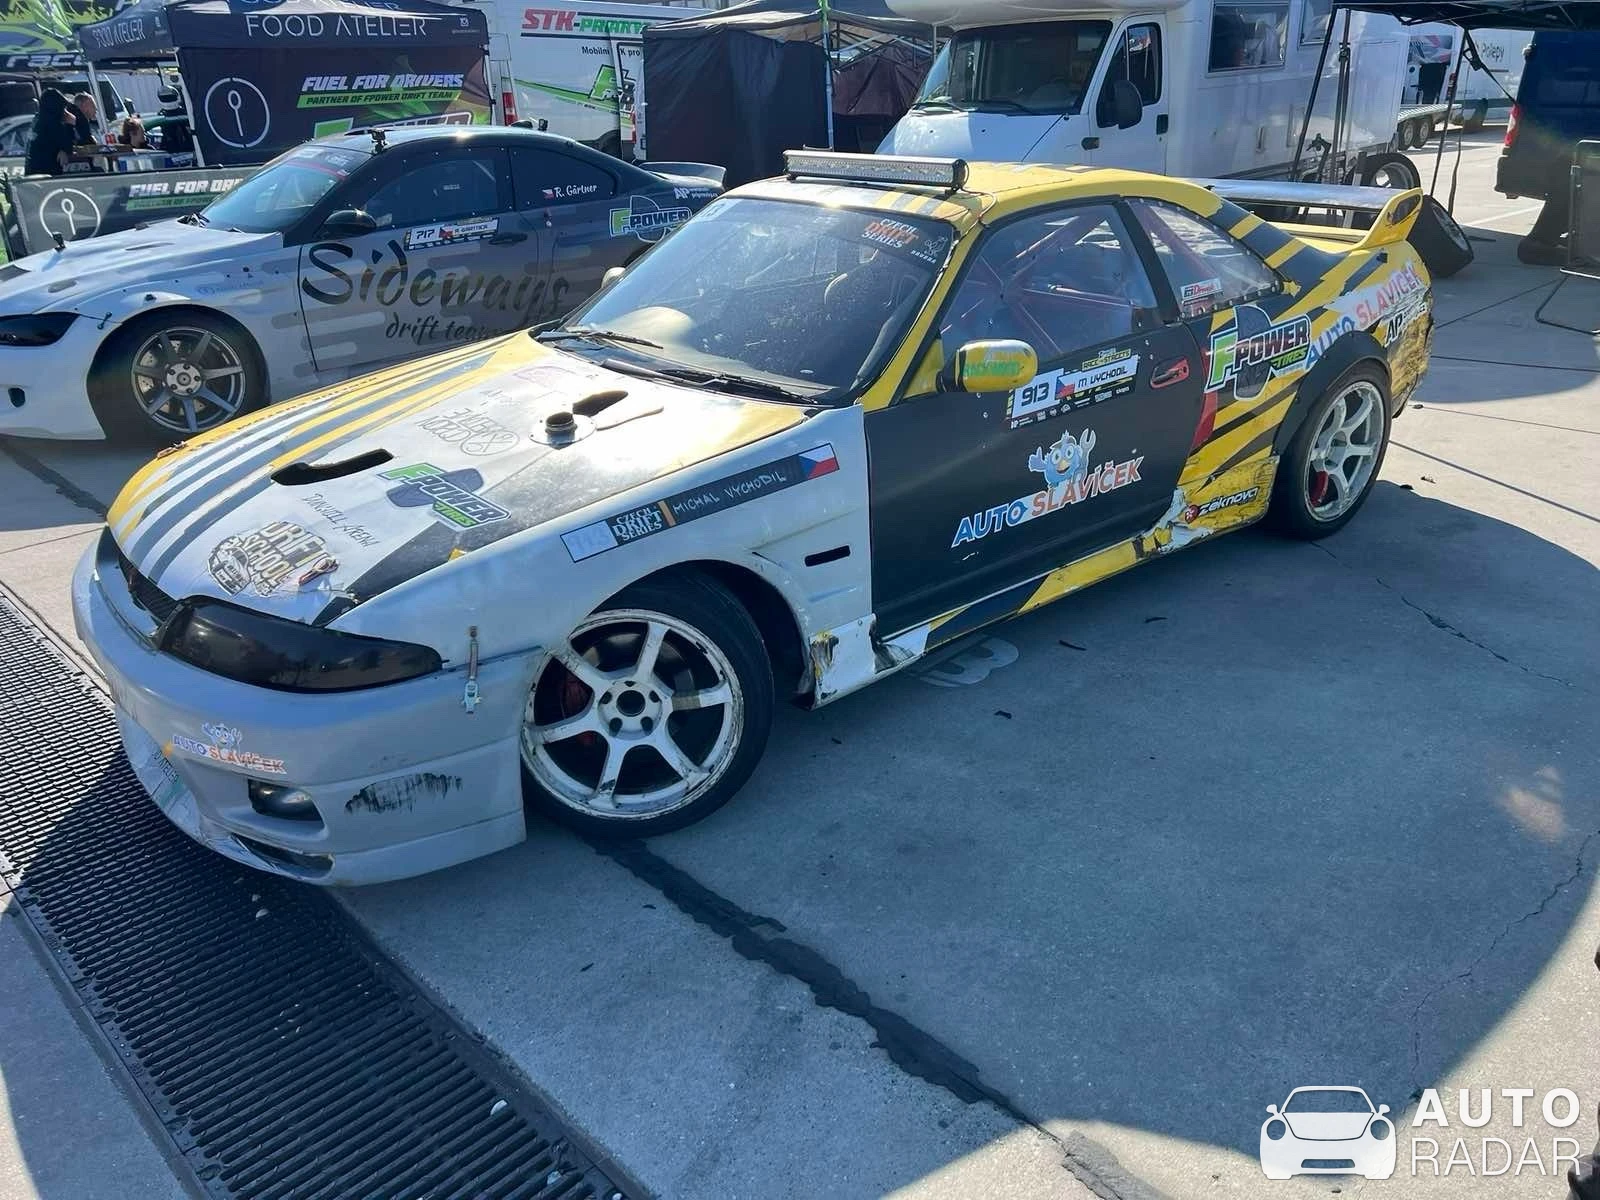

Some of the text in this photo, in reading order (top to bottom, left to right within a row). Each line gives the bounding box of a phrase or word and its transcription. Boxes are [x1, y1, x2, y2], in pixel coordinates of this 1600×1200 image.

[92, 18, 147, 48] FOOD ATELIER
[245, 15, 426, 37] FOOD ATELIER
[302, 73, 464, 92] FUEL FOR DRIVERS
[306, 91, 453, 105] PARTNER OF FPOWER DRIFT TEAM
[129, 183, 171, 197] FUEL
[173, 180, 209, 194] FOR
[554, 187, 565, 198] R.
[864, 221, 919, 244] DRIFT
[880, 218, 918, 233] CZECH
[861, 231, 905, 248] SERIES
[302, 239, 569, 325] Sideways
[385, 312, 440, 346] drift
[1209, 318, 1310, 387] FPOWER
[1272, 348, 1308, 367] TIRES
[1021, 382, 1049, 407] 913
[673, 471, 786, 515] MICHAL VYCHODIL
[951, 455, 1144, 549] AUTO SLAVÍČEK
[612, 510, 663, 536] DRIFT
[616, 507, 651, 525] CZECH
[622, 521, 662, 541] SERIES
[242, 533, 296, 587] SCHOOL
